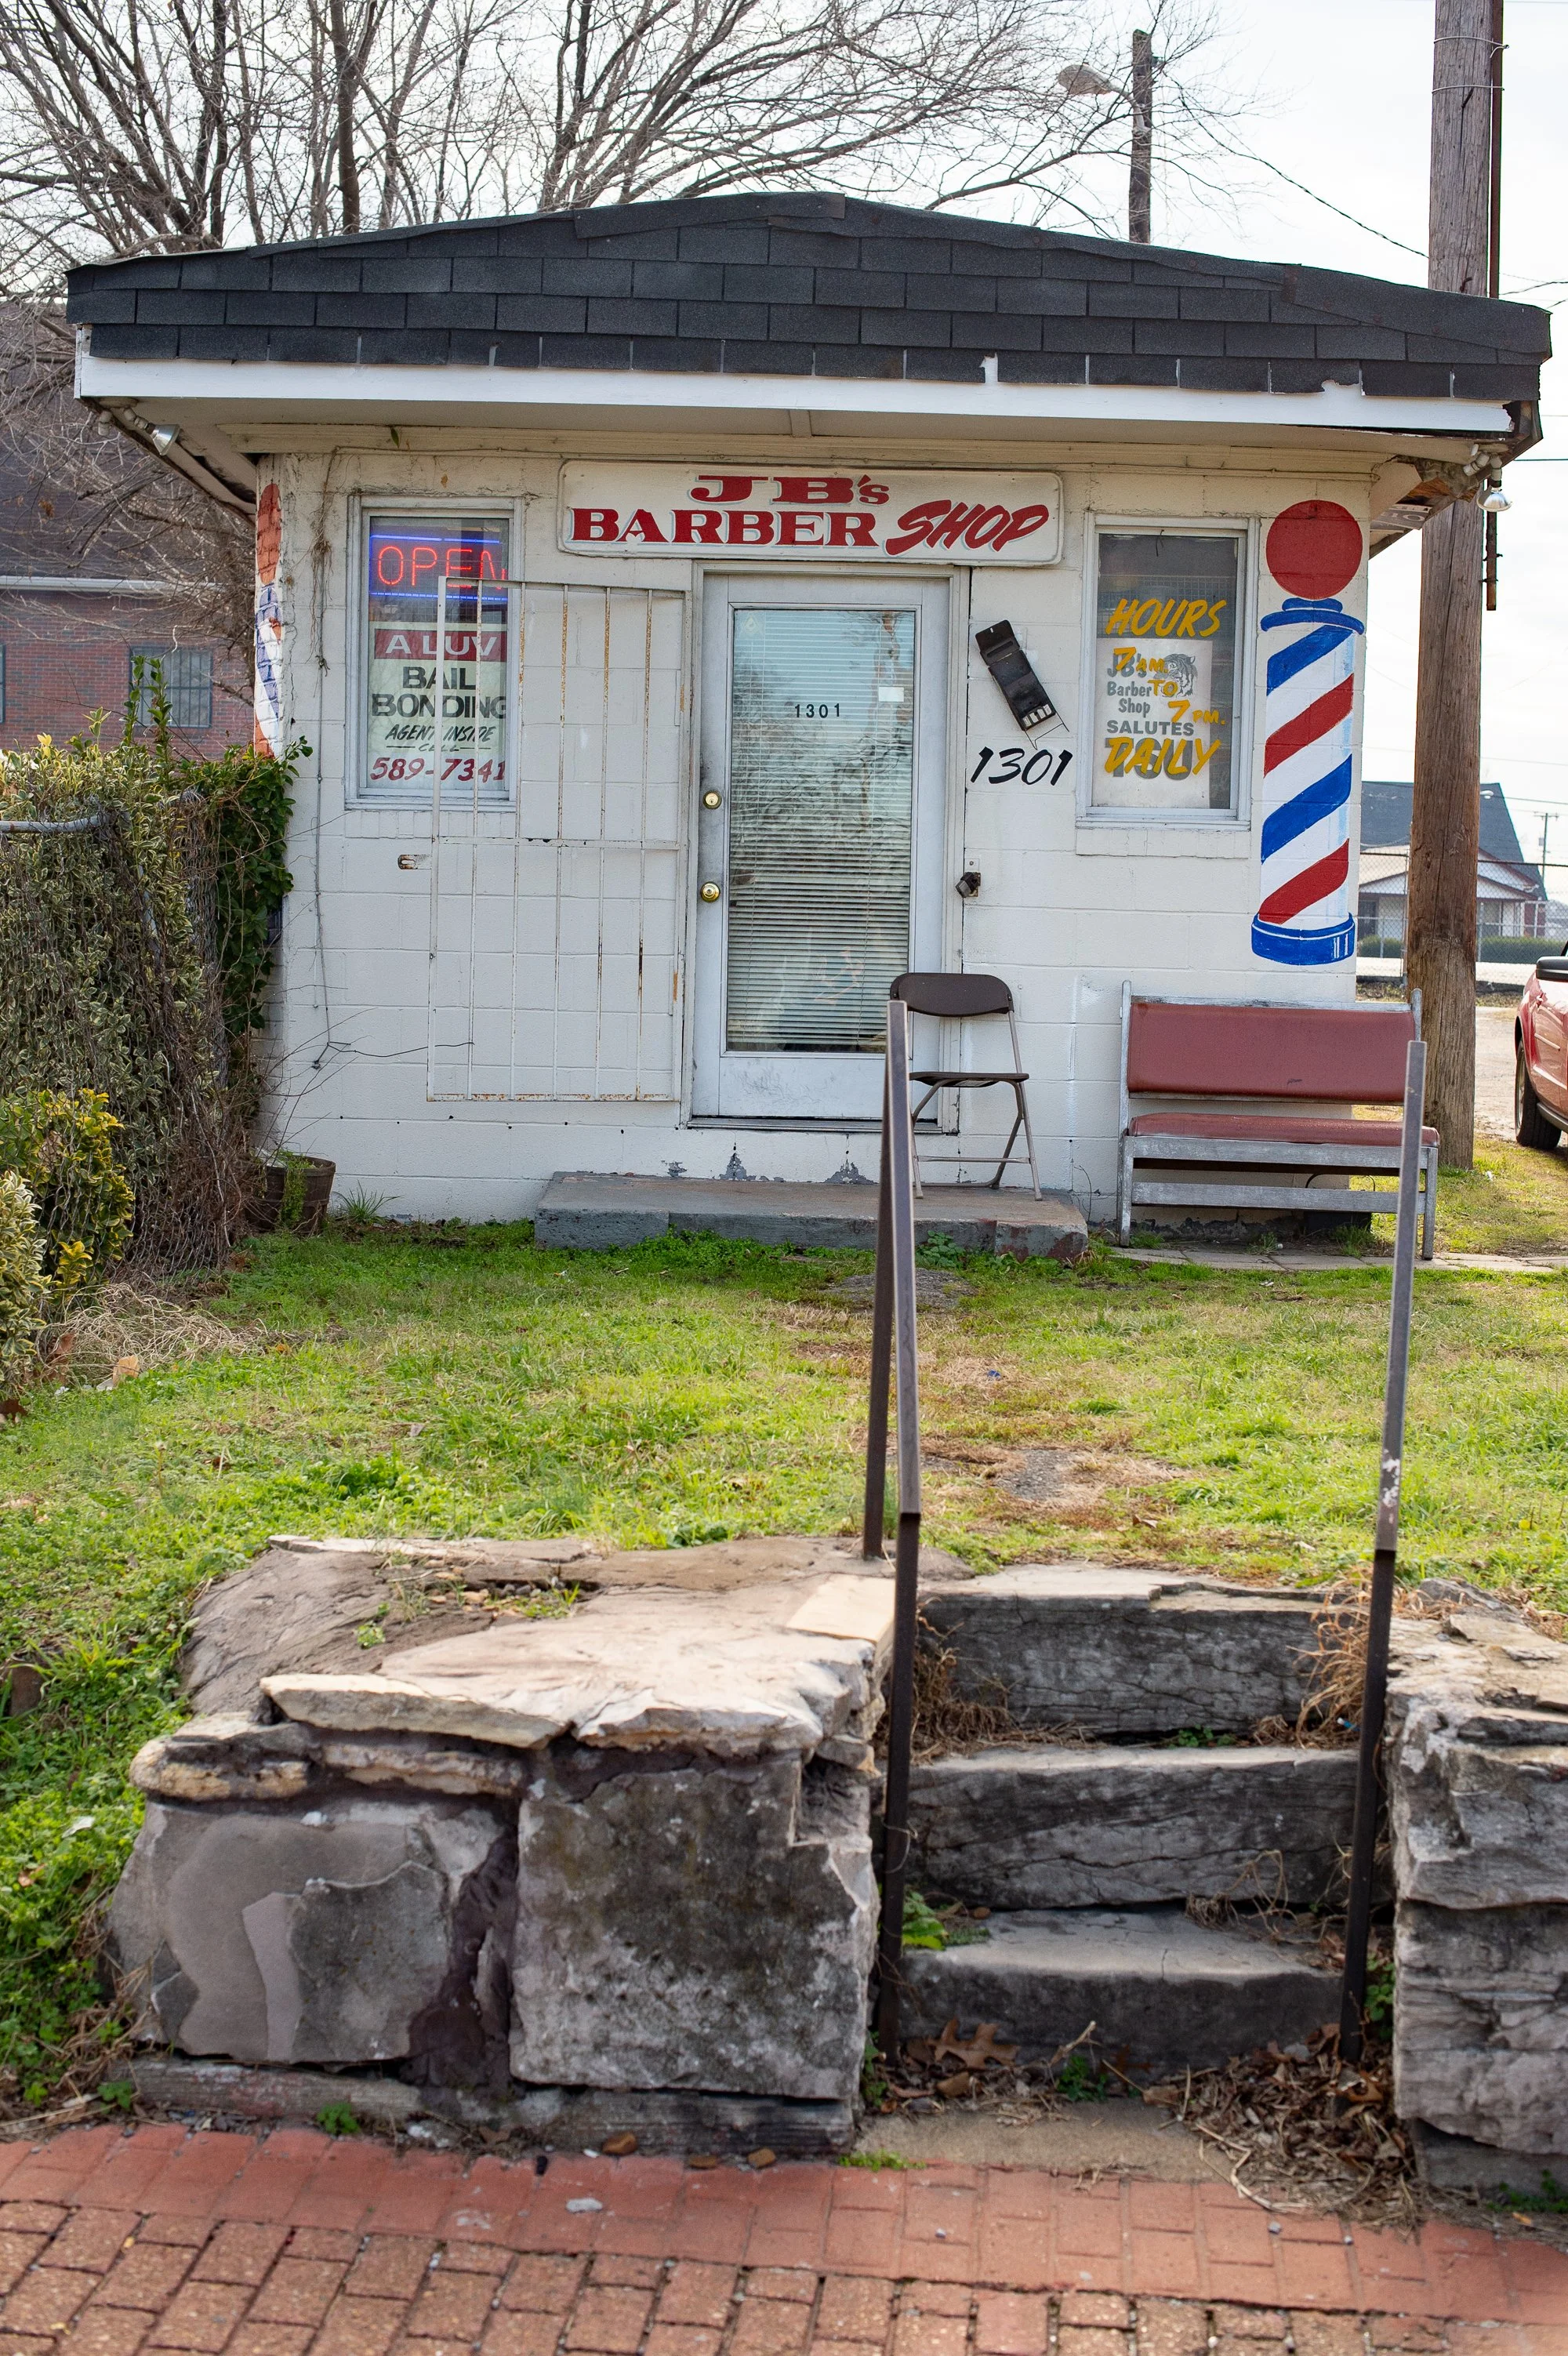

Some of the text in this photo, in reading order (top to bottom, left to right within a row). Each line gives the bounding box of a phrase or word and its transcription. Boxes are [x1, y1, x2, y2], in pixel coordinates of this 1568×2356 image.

[690, 474, 891, 506] JB's
[569, 499, 1050, 556] BARBER SHOP
[377, 545, 507, 590] OPEN
[1105, 597, 1228, 637] HOURS
[385, 634, 498, 656] A LUV
[1113, 646, 1137, 672] 7
[402, 666, 477, 691] BAIL
[1107, 681, 1152, 697] Barber
[1147, 679, 1179, 697] TO
[372, 693, 506, 719] BONDING
[793, 702, 841, 719] 1301
[1118, 698, 1151, 718] Shop
[1167, 699, 1191, 724] 7
[1106, 720, 1195, 736] SALUTES
[971, 746, 1073, 786] 1301
[1104, 735, 1222, 775] DAILY
[369, 757, 506, 783] 589-7341
